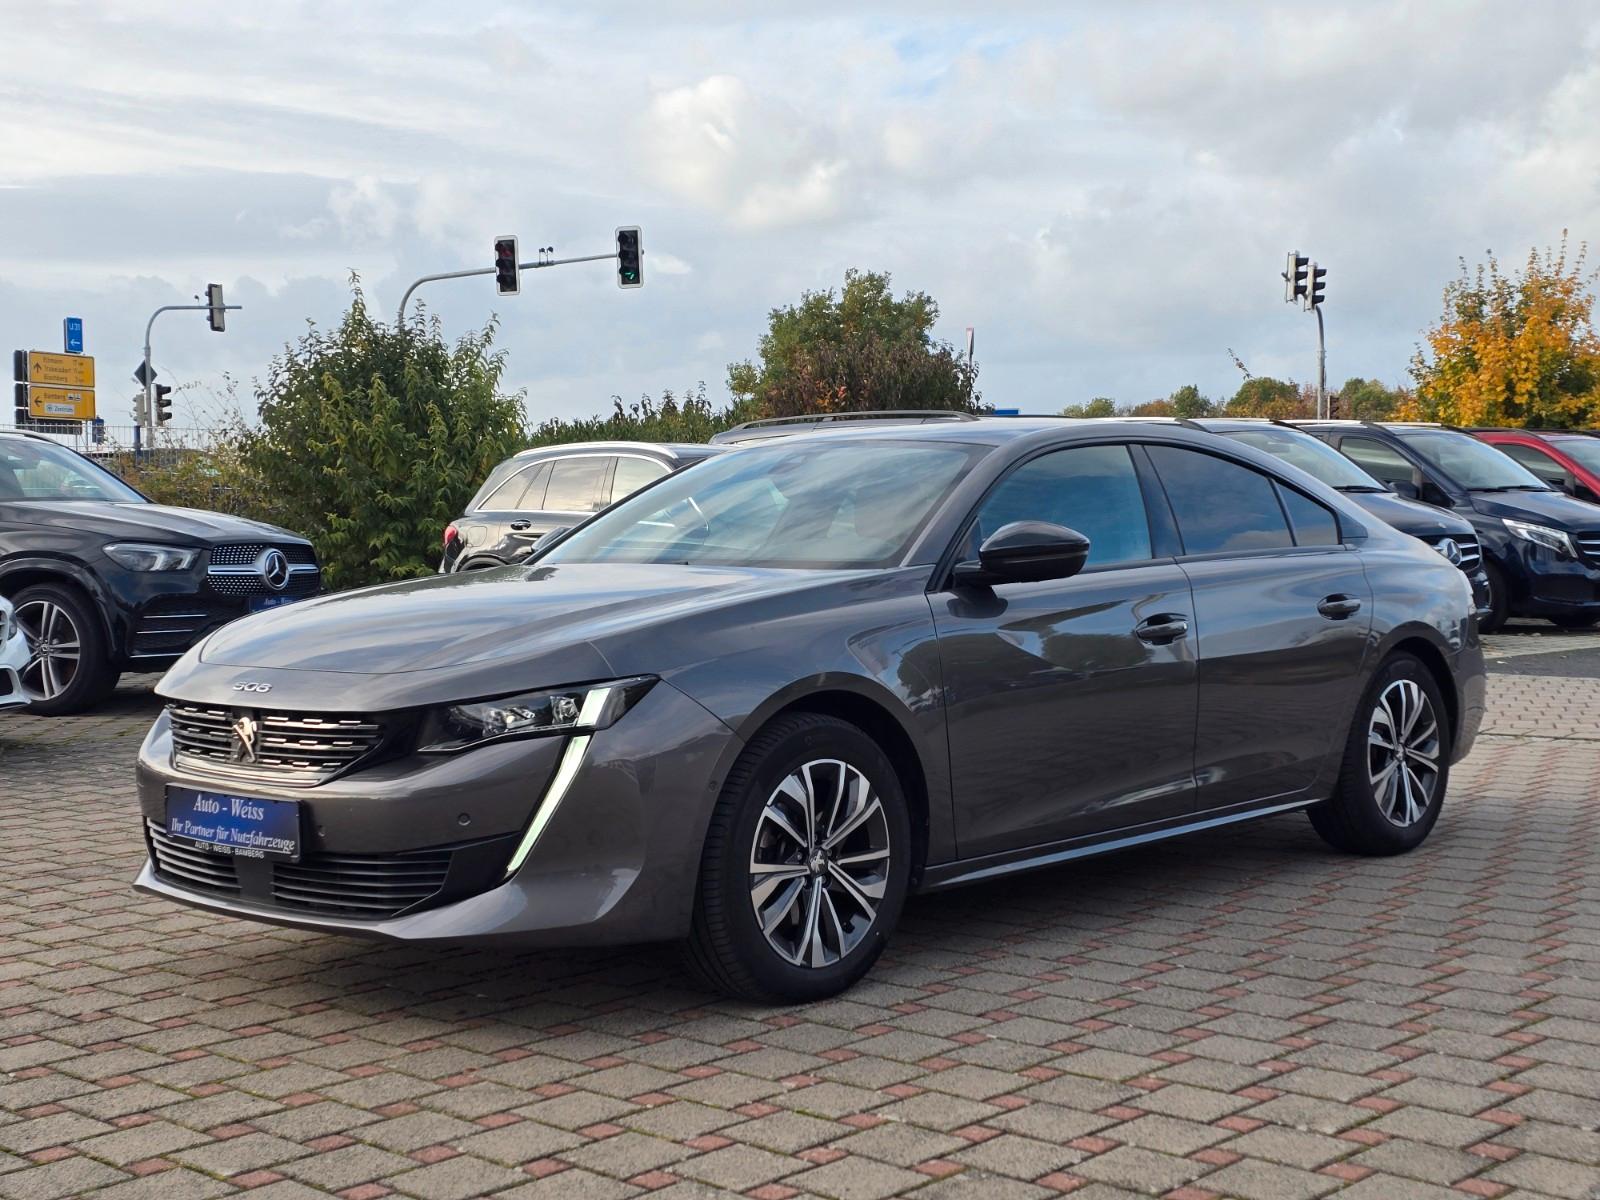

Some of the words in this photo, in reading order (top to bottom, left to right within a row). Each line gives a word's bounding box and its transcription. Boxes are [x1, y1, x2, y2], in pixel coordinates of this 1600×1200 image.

[232, 681, 273, 693] 508
[193, 793, 220, 814] Auto
[231, 798, 265, 821] Weiss
[171, 818, 183, 832] Ihr
[184, 820, 215, 838] Partner
[215, 826, 229, 842] für
[230, 828, 295, 852] Nutzfahrzeuge
[194, 841, 209, 851] AUTO
[213, 844, 231, 855] WEISS
[235, 847, 265, 859] BAMBERG
